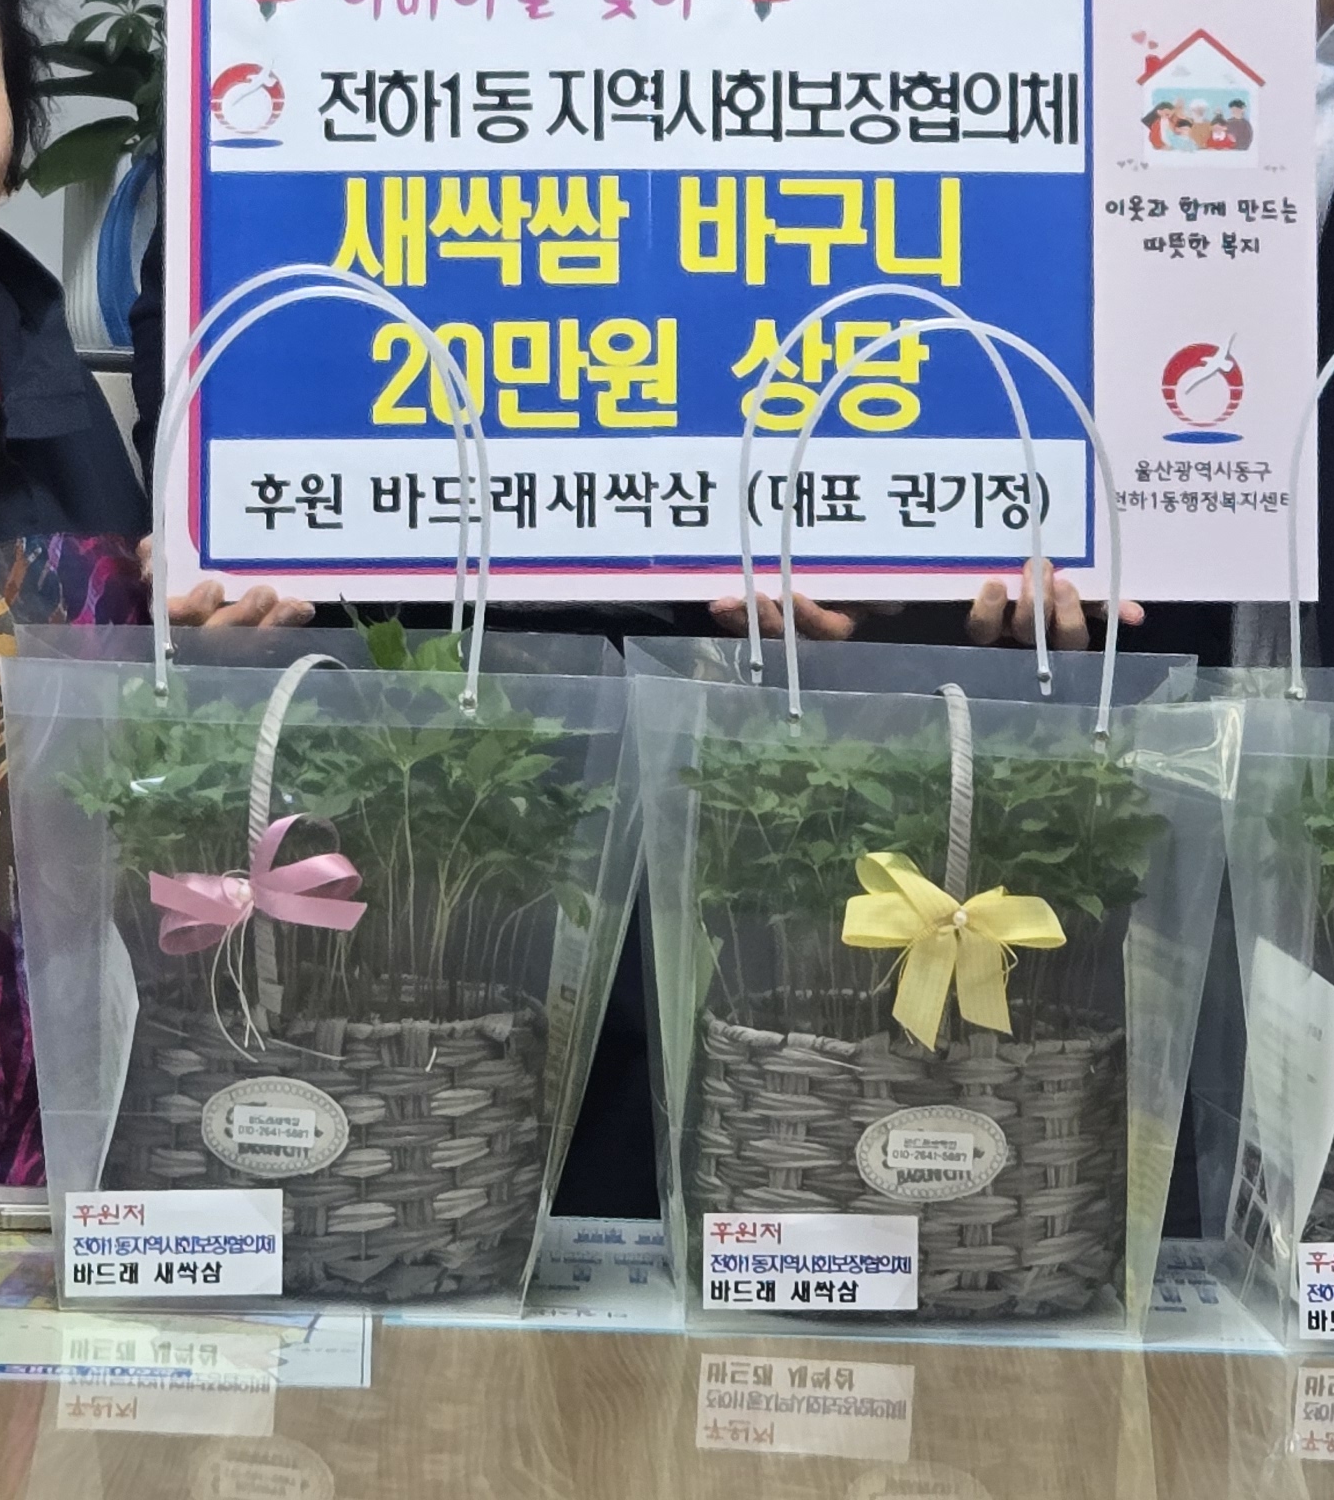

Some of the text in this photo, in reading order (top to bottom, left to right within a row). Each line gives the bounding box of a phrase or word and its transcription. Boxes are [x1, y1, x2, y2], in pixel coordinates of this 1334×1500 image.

[1104, 194, 1298, 224] 이웃과 함께 만드는
[332, 175, 963, 288] 새싹쌈 바구니
[1143, 231, 1260, 260] 따뜻한 복지
[371, 317, 930, 432] 20만원 상당
[244, 470, 1051, 532] 후원 바드래새싹삼 (대표 권기정)
[73, 1261, 223, 1286] 바드래 새싹삼
[710, 1279, 860, 1303] 바드래 새싹삼
